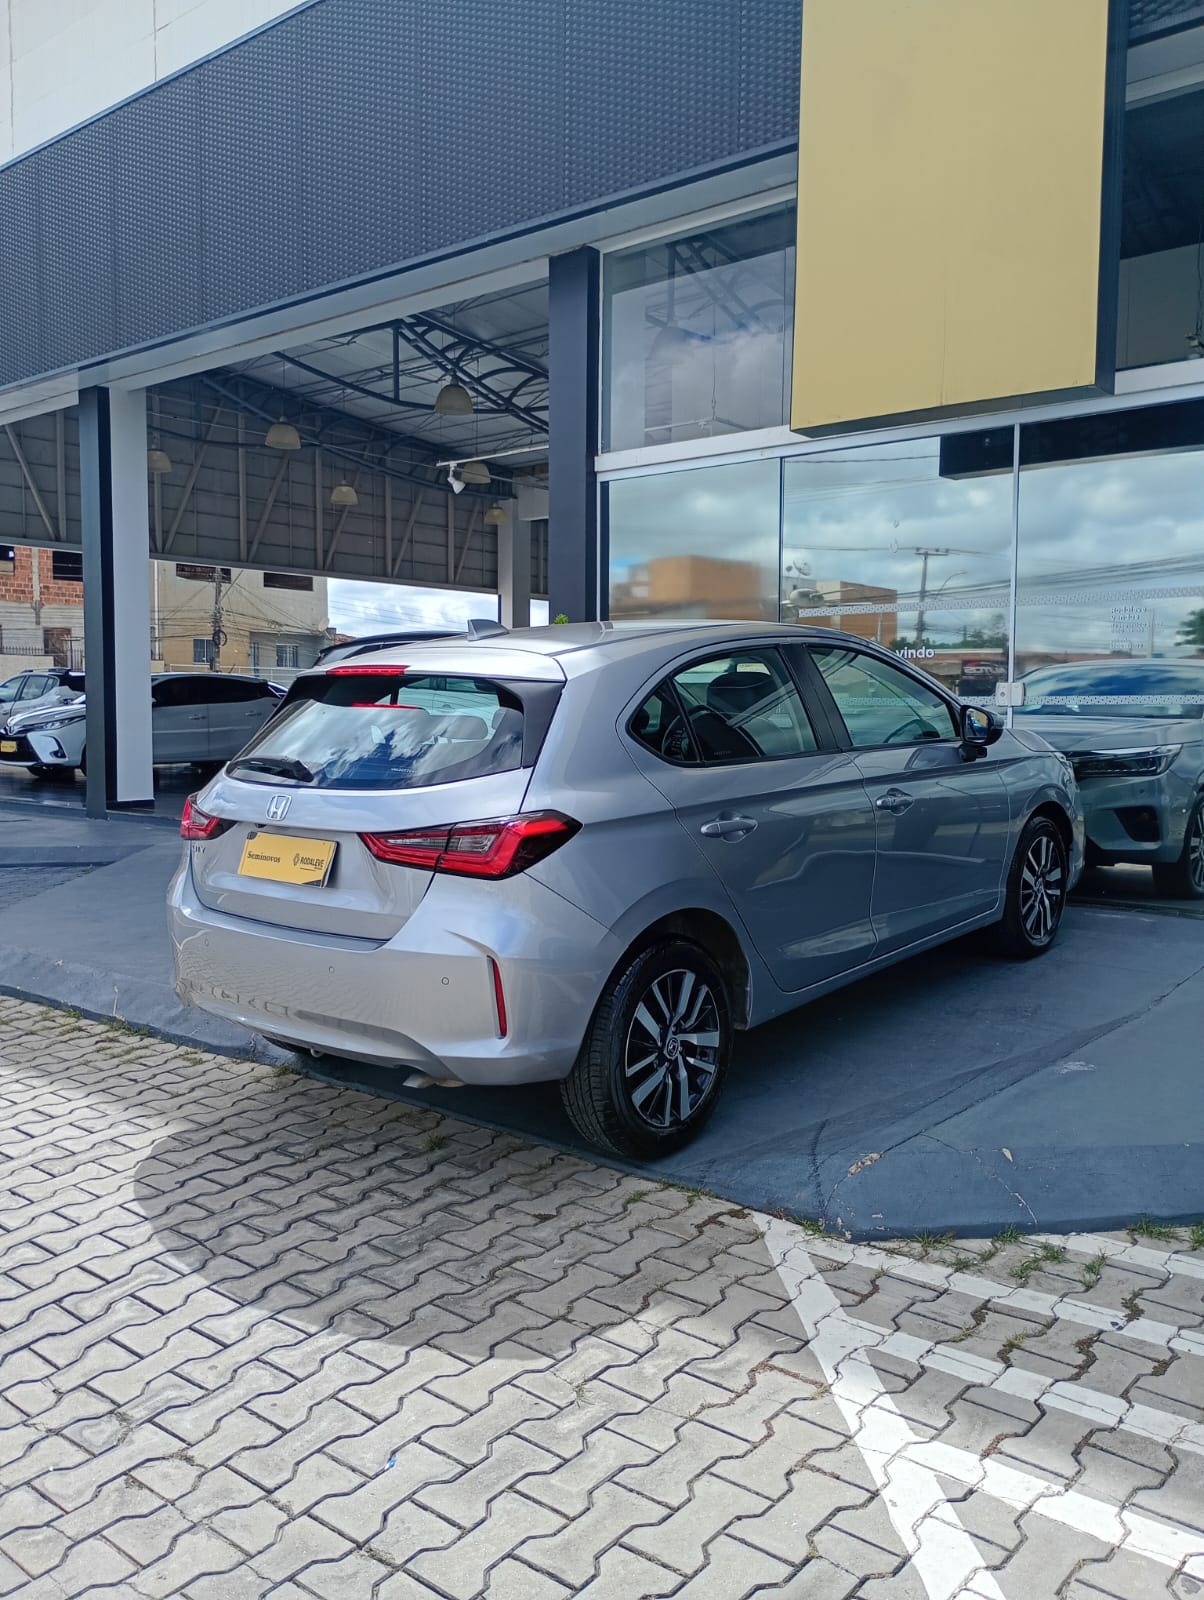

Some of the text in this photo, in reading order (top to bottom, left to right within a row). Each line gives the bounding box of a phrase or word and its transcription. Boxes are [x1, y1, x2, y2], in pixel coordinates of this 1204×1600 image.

[895, 645, 935, 659] vindo
[247, 850, 325, 868] Seminovos RODALEVE
